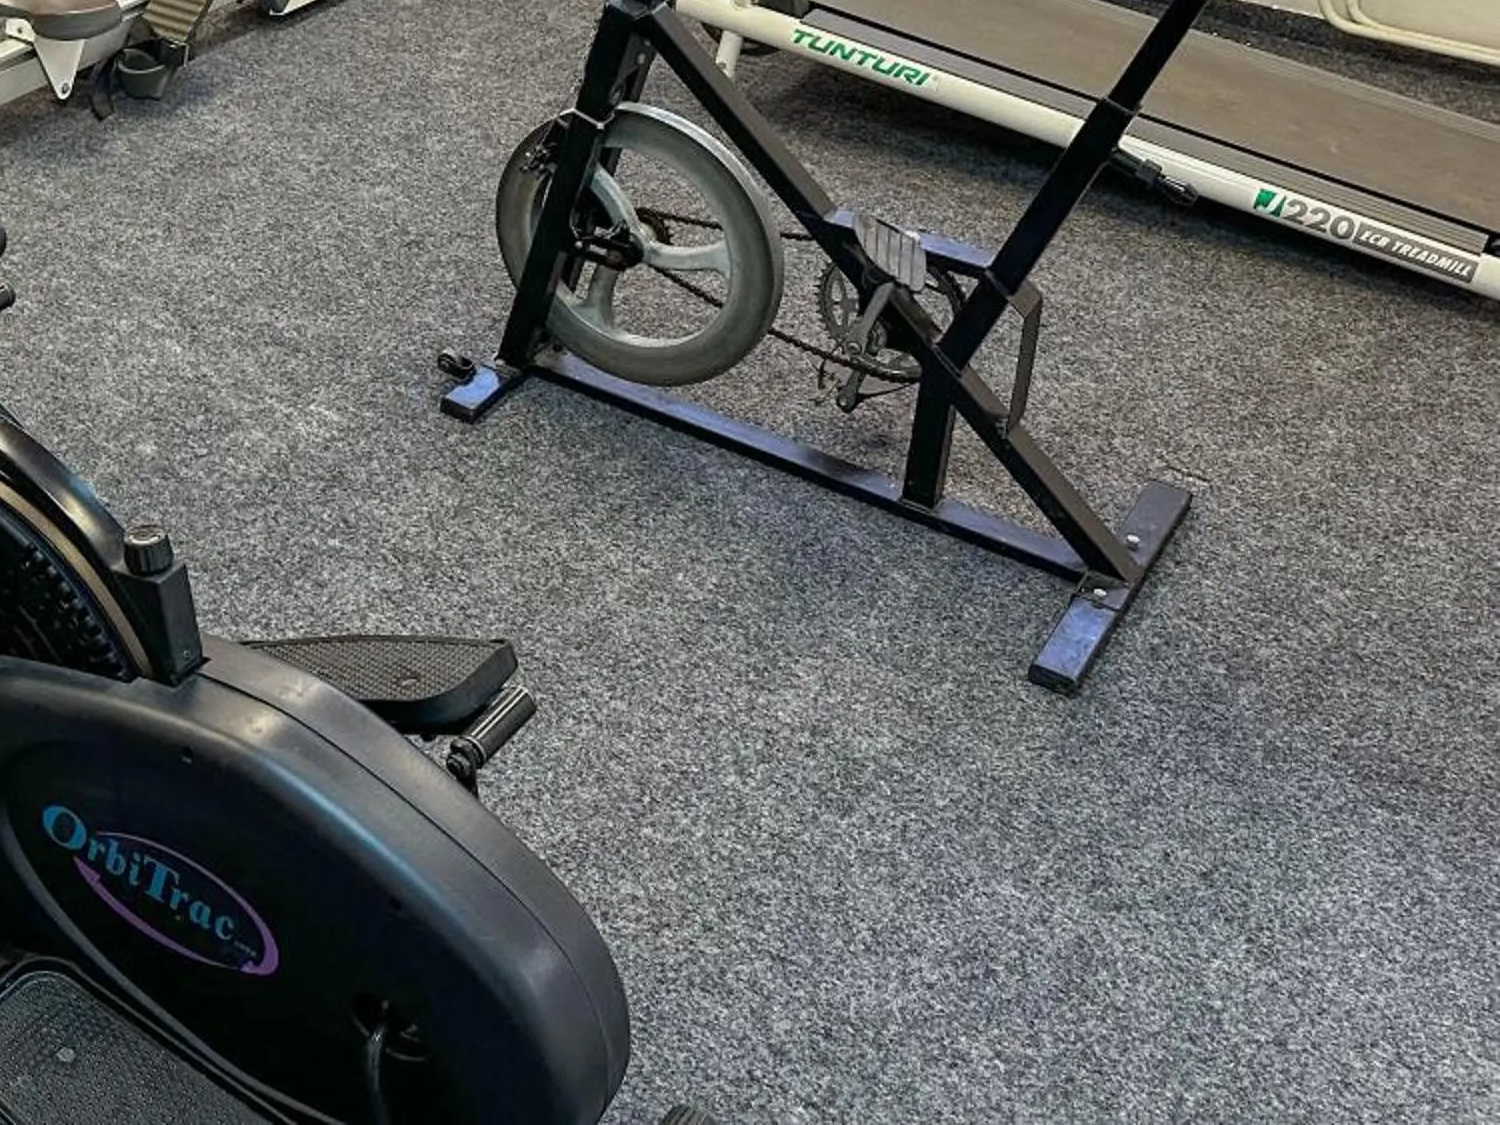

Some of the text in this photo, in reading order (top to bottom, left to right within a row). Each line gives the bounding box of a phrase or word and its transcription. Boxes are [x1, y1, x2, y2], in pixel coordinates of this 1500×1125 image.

[793, 29, 931, 86] TUNTURI
[1392, 240, 1474, 277] TREADMILL
[43, 805, 235, 941] OrbiTrac
